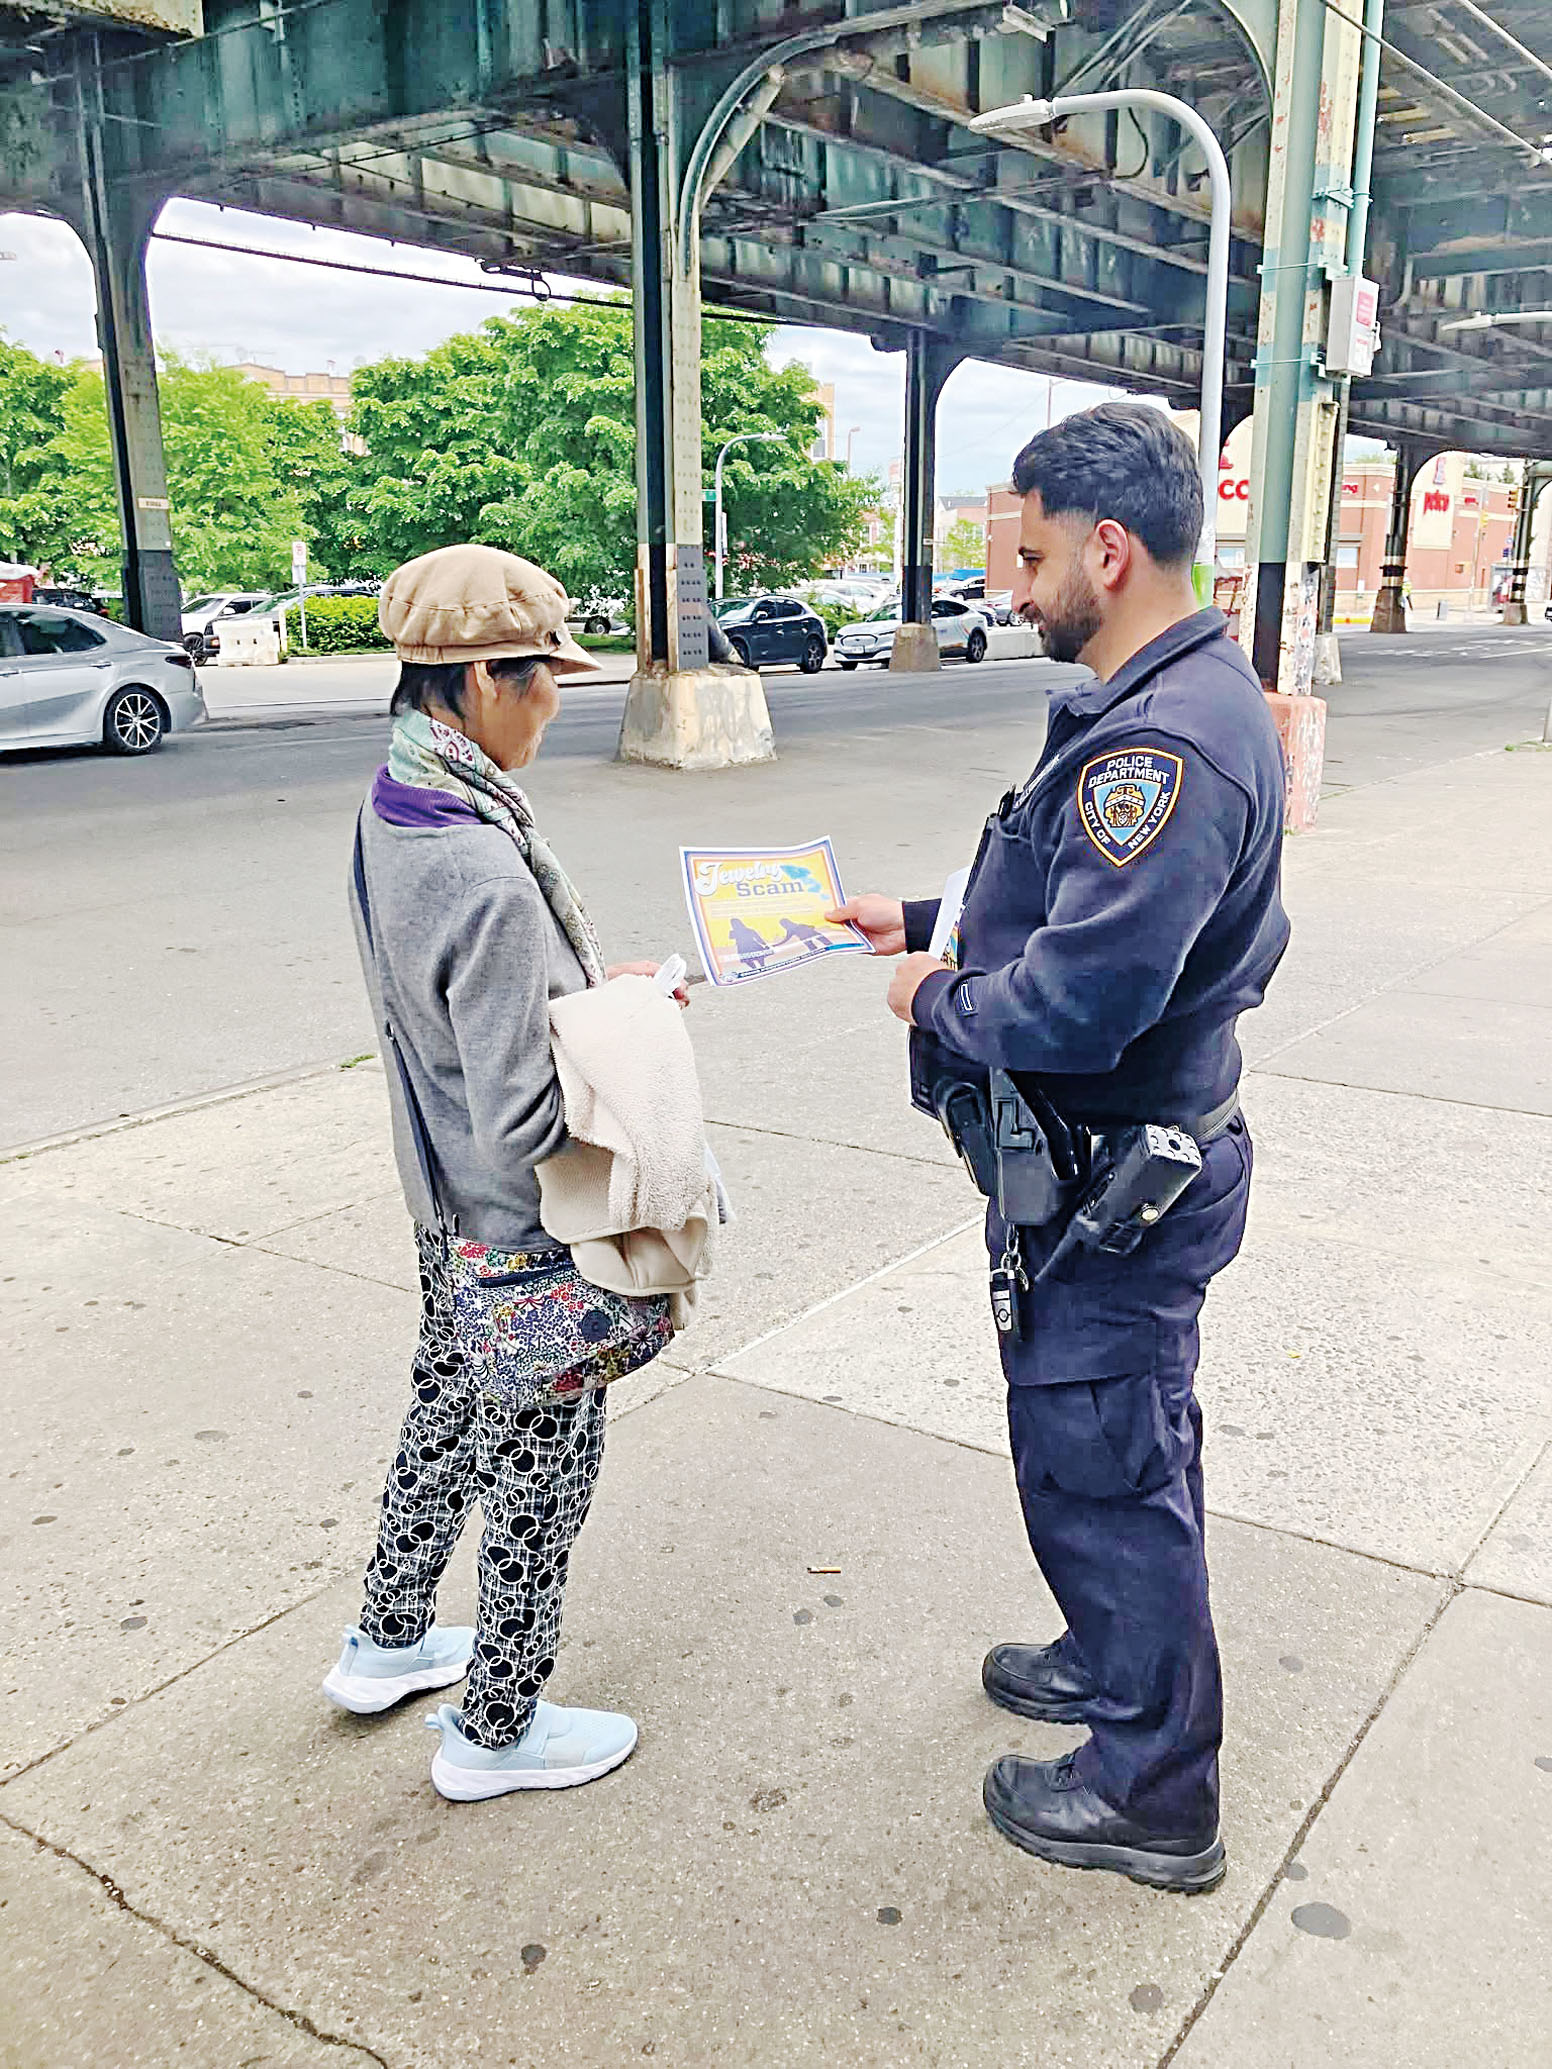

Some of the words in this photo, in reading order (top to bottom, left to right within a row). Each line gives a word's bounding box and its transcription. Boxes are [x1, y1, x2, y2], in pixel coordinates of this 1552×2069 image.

[1106, 755, 1154, 771] POLICE
[1088, 767, 1170, 789] DEPARTMENT
[1084, 801, 1101, 828] CITY
[1096, 830, 1111, 845] OF
[1127, 825, 1152, 849] NEW
[1147, 791, 1171, 825] YORK
[694, 861, 784, 897] Jewelry
[736, 881, 804, 897] Scam
